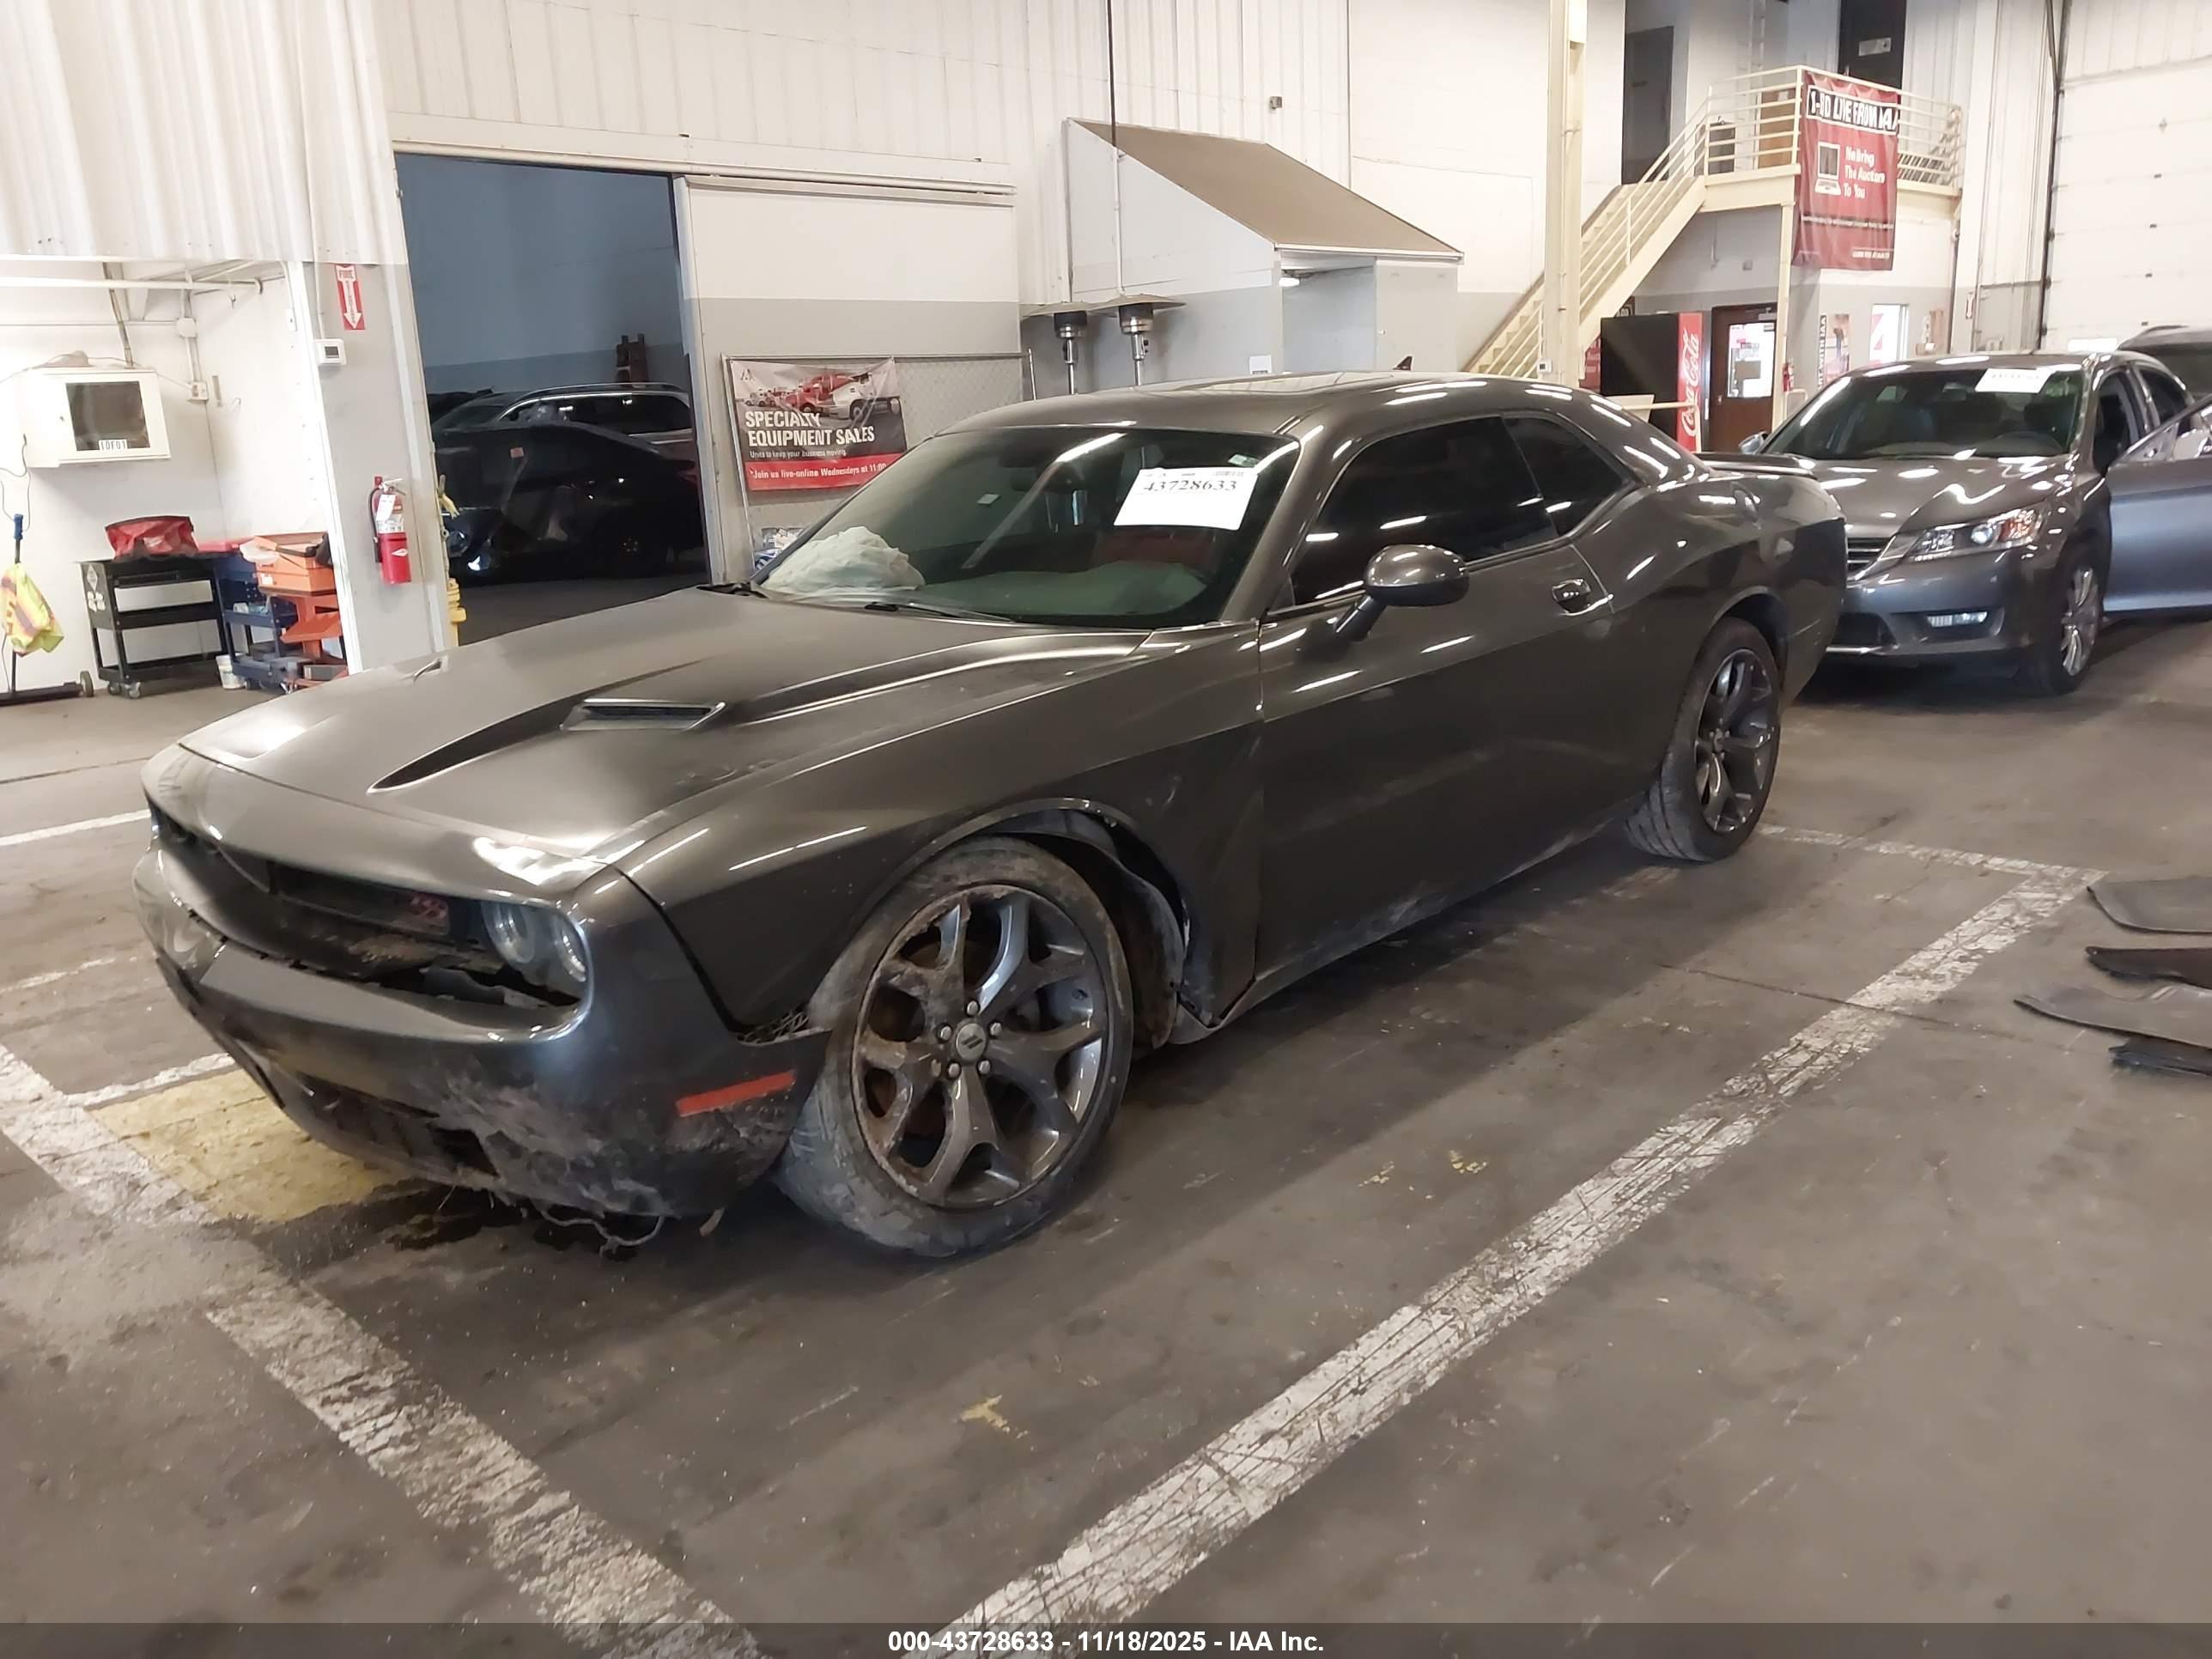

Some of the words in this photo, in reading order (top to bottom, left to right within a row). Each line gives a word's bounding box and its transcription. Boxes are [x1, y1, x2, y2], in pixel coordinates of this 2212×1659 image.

[1844, 164, 1857, 179] The
[1843, 182, 1852, 198] To
[1854, 183, 1866, 199] You
[745, 410, 821, 428] SPECIALTY
[748, 428, 833, 447] EQUIPMENT
[836, 425, 875, 445] SALES
[750, 450, 765, 459] Units
[772, 450, 786, 460] keep
[787, 451, 800, 459] your
[825, 448, 847, 458] moving
[753, 470, 769, 479] Join
[781, 468, 819, 478] live-online
[821, 466, 860, 477] Wednesdays
[860, 465, 867, 473] at
[1143, 479, 1237, 492] 43728633
